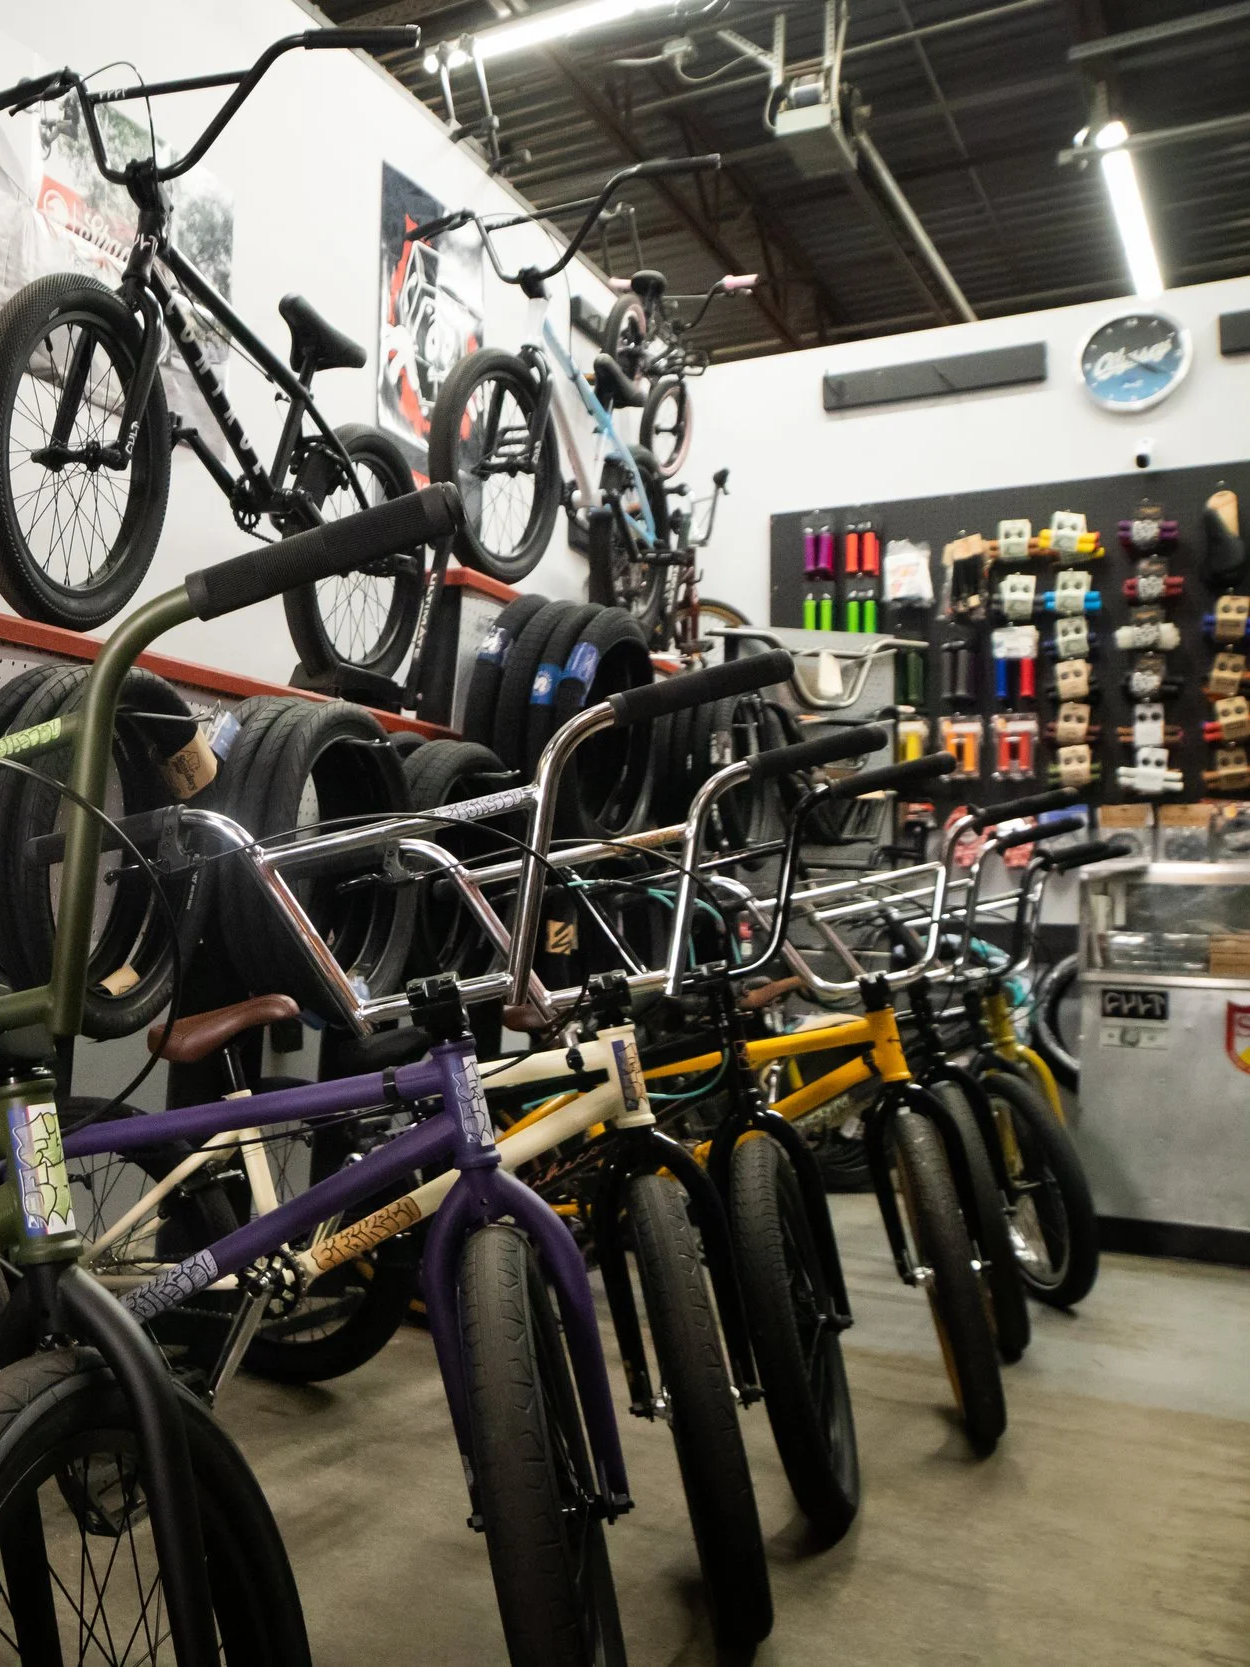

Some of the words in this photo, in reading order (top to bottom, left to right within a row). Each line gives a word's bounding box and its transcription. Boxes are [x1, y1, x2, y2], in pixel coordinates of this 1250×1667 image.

[124, 420, 141, 455] CULT
[412, 572, 438, 659] ULTIMATE
[1104, 991, 1166, 1018] CULT
